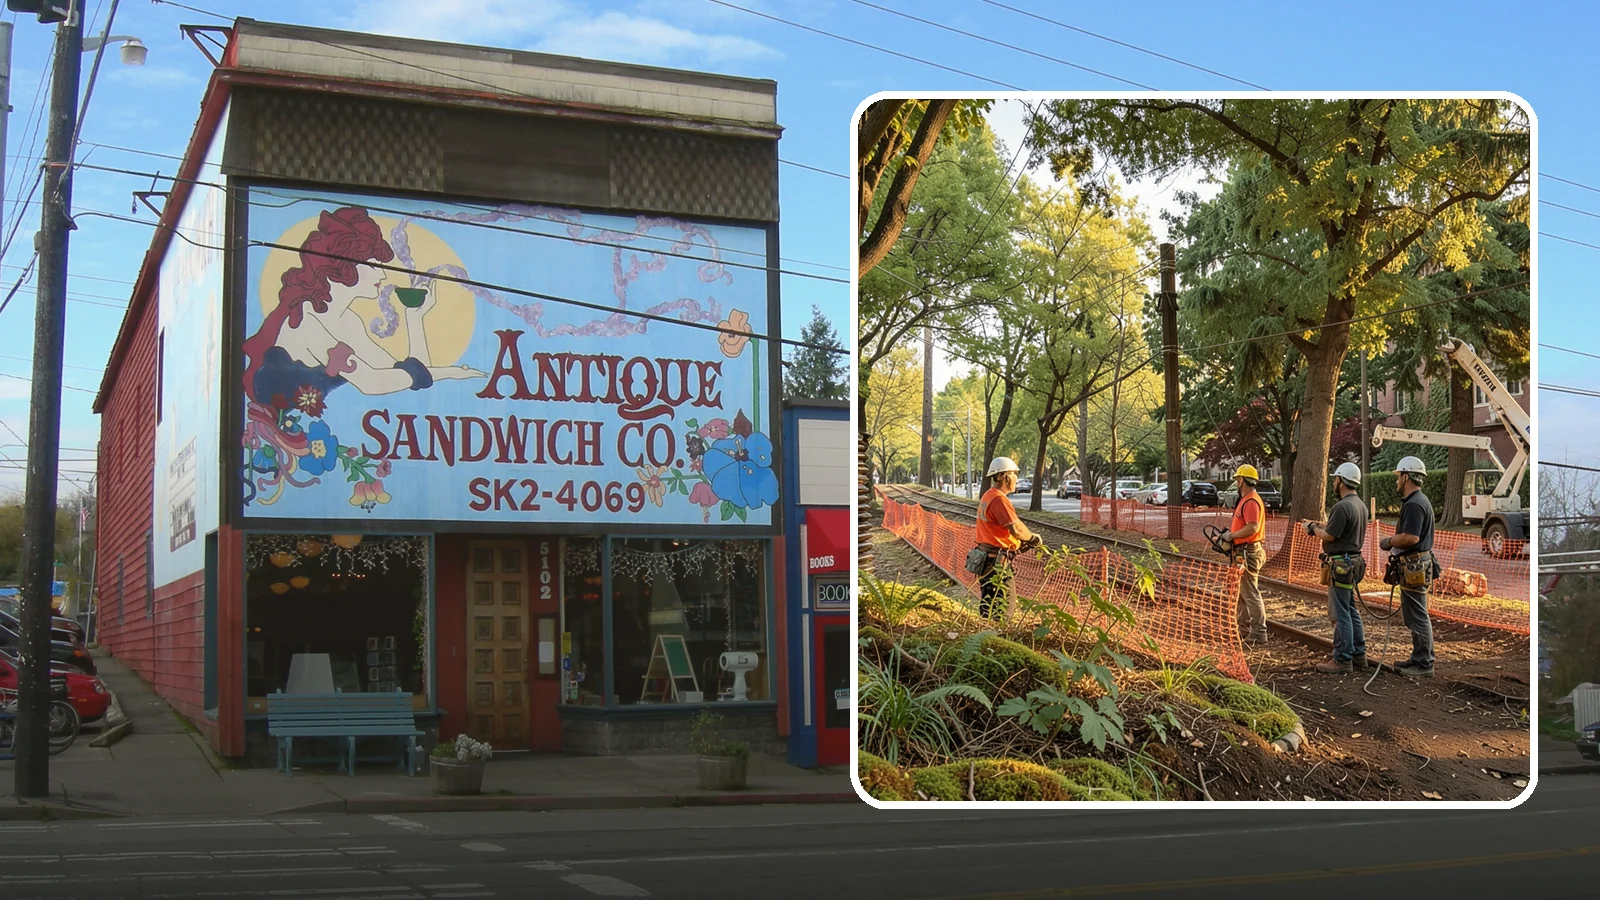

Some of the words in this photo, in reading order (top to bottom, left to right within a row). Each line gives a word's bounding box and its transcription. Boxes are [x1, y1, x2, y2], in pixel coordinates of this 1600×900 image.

[476, 329, 723, 420] ANTIQUE
[361, 408, 604, 467] SANDWICH
[617, 422, 685, 468] CO.
[468, 477, 645, 513] SK2-4069
[540, 541, 551, 600] 5102
[809, 555, 835, 569] BOOKS
